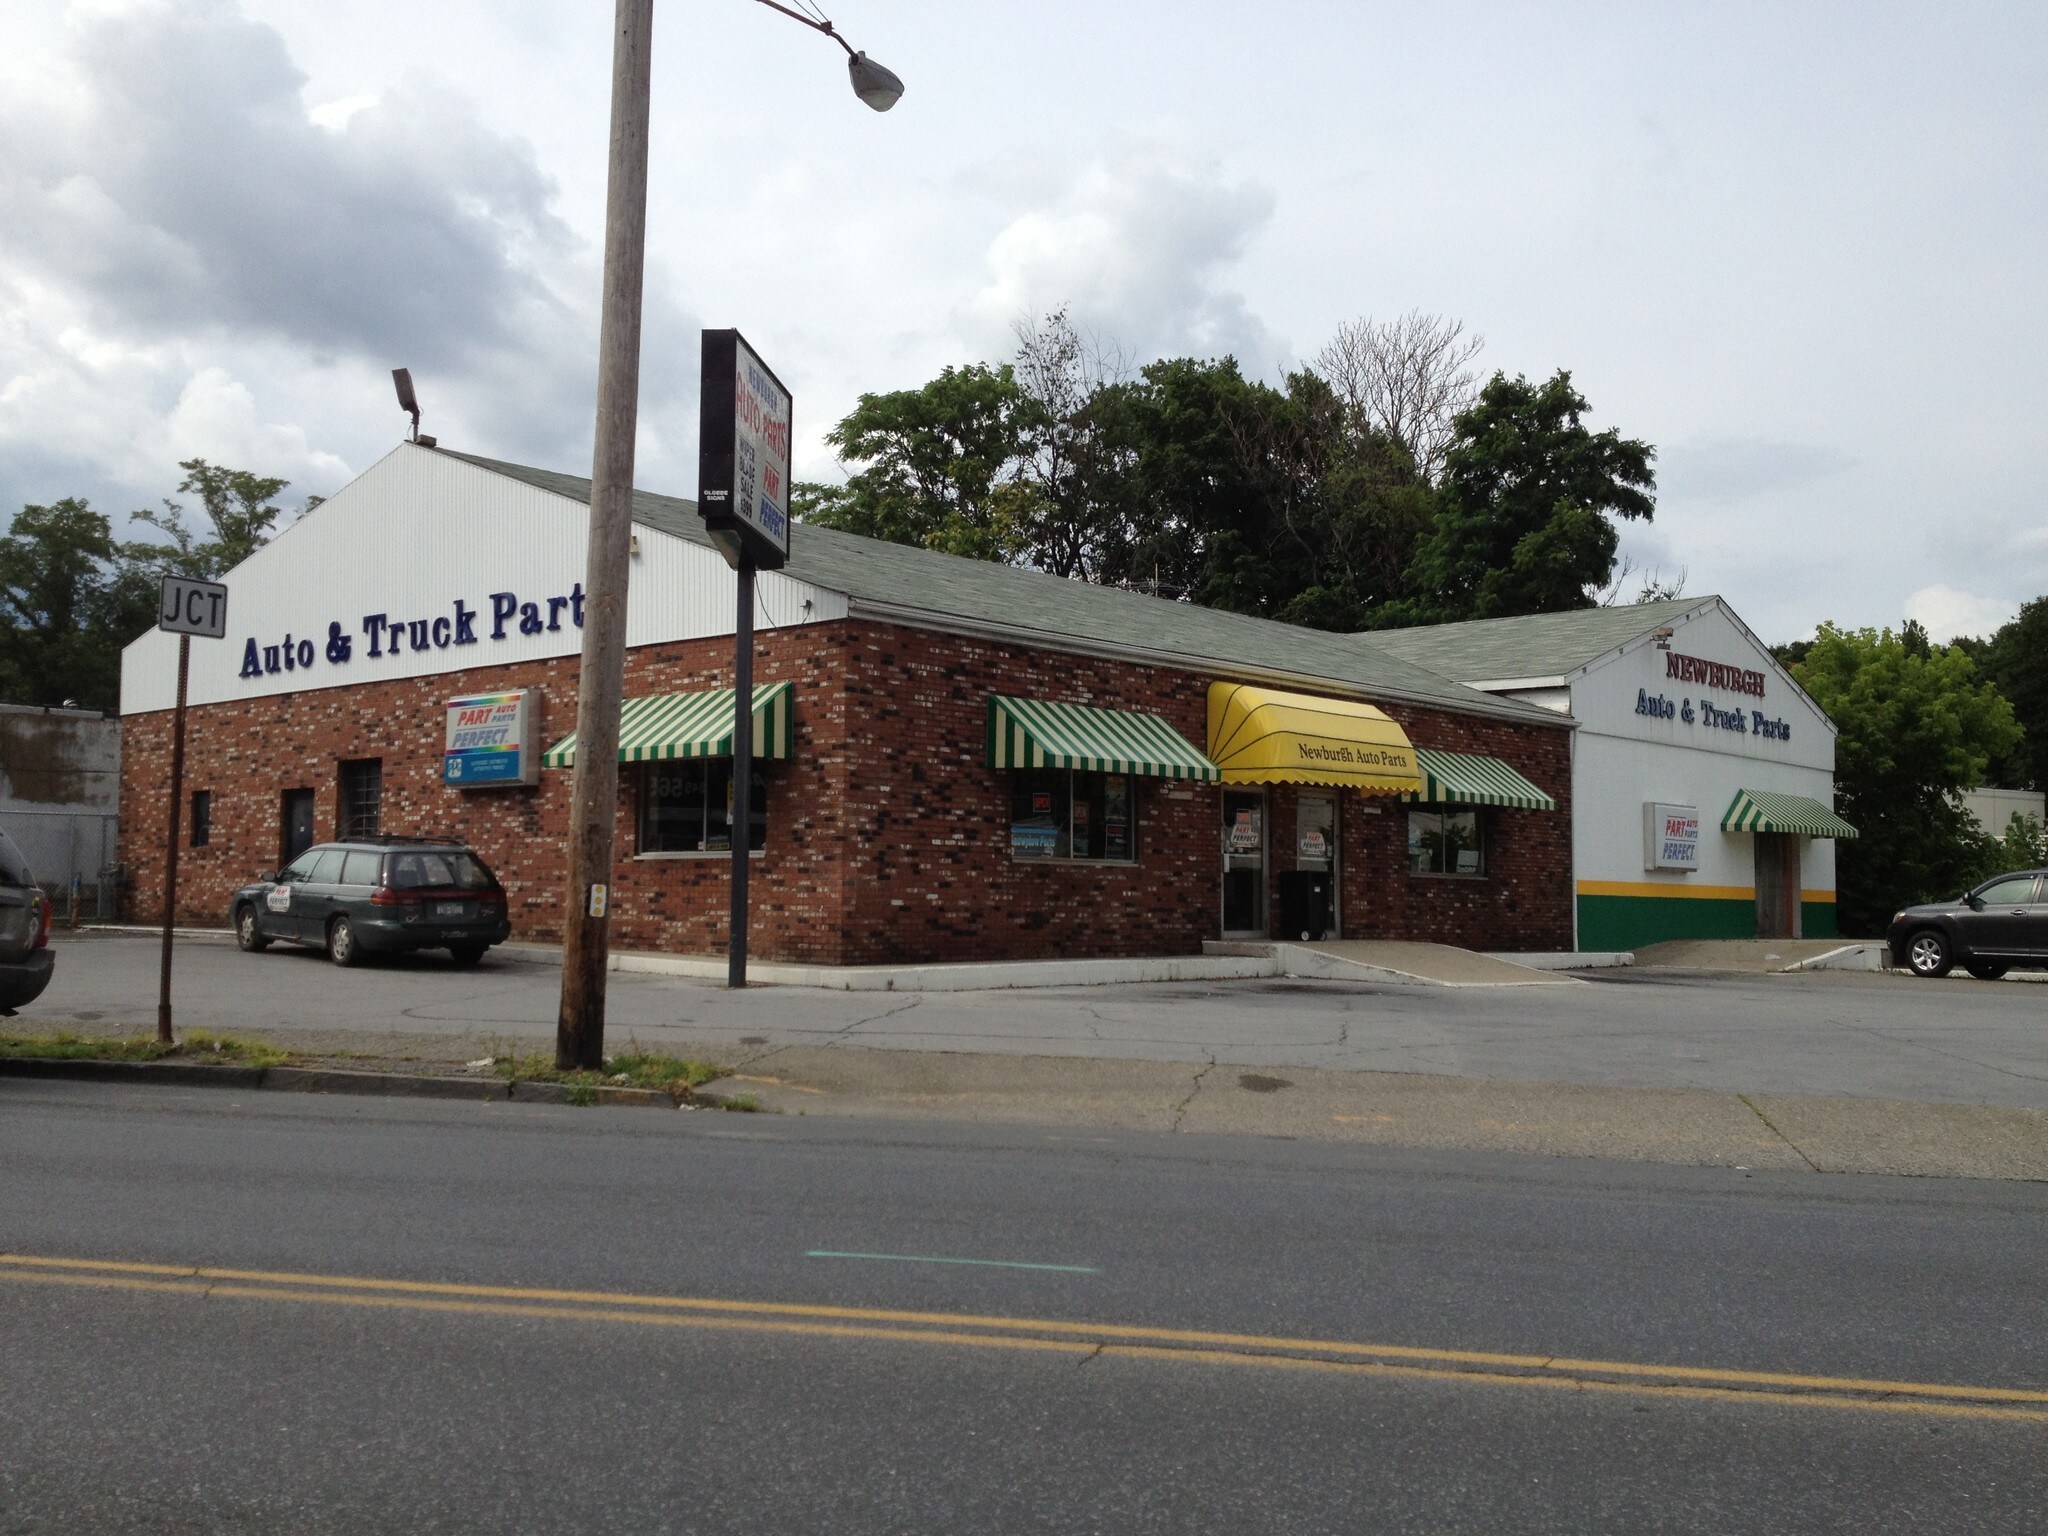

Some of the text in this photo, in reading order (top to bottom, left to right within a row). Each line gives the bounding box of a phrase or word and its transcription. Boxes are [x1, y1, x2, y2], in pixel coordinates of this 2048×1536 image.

[736, 371, 786, 462] AUTO PARTS
[740, 477, 753, 501] SALE
[763, 464, 780, 500] PART
[760, 498, 785, 540] PERFECT
[164, 586, 223, 629] JCT
[238, 582, 586, 679] Auto & Truck Part
[1666, 651, 1766, 698] NEWBURGH
[457, 704, 517, 727] PART AUTO
[491, 713, 516, 723] PARTS
[1635, 687, 1791, 742] Auto & Truck Parts
[452, 728, 509, 748] PERFECT
[1298, 743, 1407, 768] Newburgh Auto Parts
[1665, 819, 1686, 837] PART
[1302, 841, 1324, 850] PERFECT
[1662, 842, 1696, 861] PERFECT
